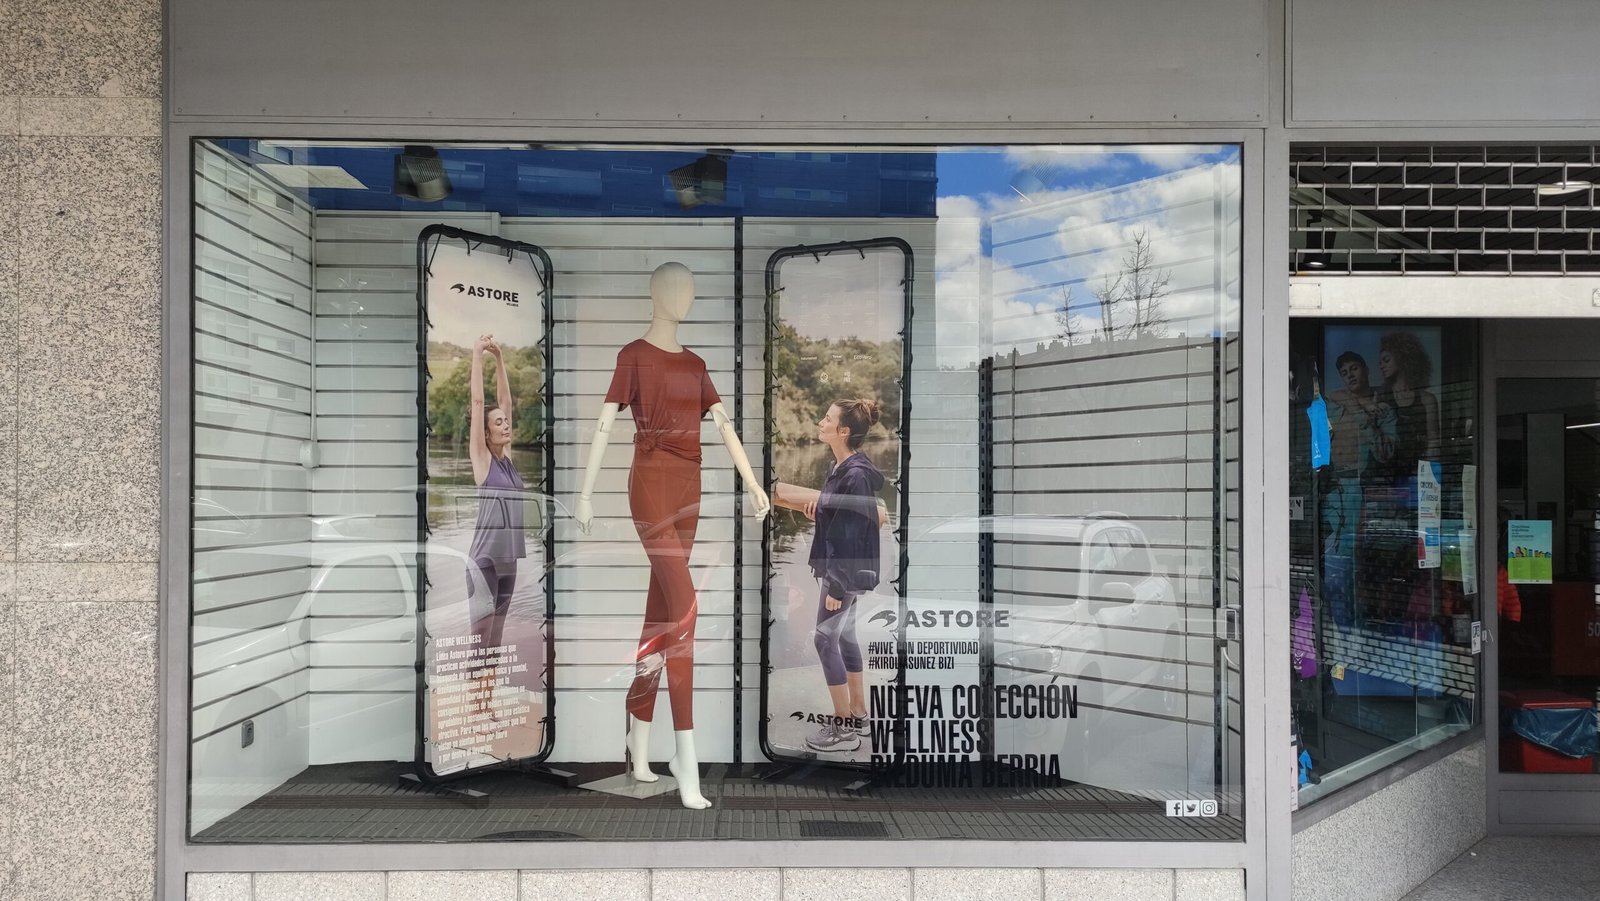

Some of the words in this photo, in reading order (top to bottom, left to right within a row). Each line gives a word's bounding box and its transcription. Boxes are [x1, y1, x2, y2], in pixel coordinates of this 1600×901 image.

[467, 285, 519, 303] ASTORE
[902, 609, 1010, 628] ASTORE
[436, 637, 455, 648] ASTORE
[456, 634, 481, 646] WELLNESS
[868, 641, 893, 655] #VIVE
[897, 641, 915, 655] CON
[917, 641, 979, 655] DEPORTIVIDAD
[449, 650, 465, 660] Astore
[486, 646, 508, 656] personas
[459, 659, 485, 669] actividades
[868, 656, 936, 670] #KIROLASUNEZ
[938, 656, 955, 670] BIZI
[870, 685, 943, 719] NUEVA
[952, 675, 1078, 719] COLECCIÓN
[806, 713, 863, 729] ASTORE
[982, 754, 1062, 788] BERRIA
